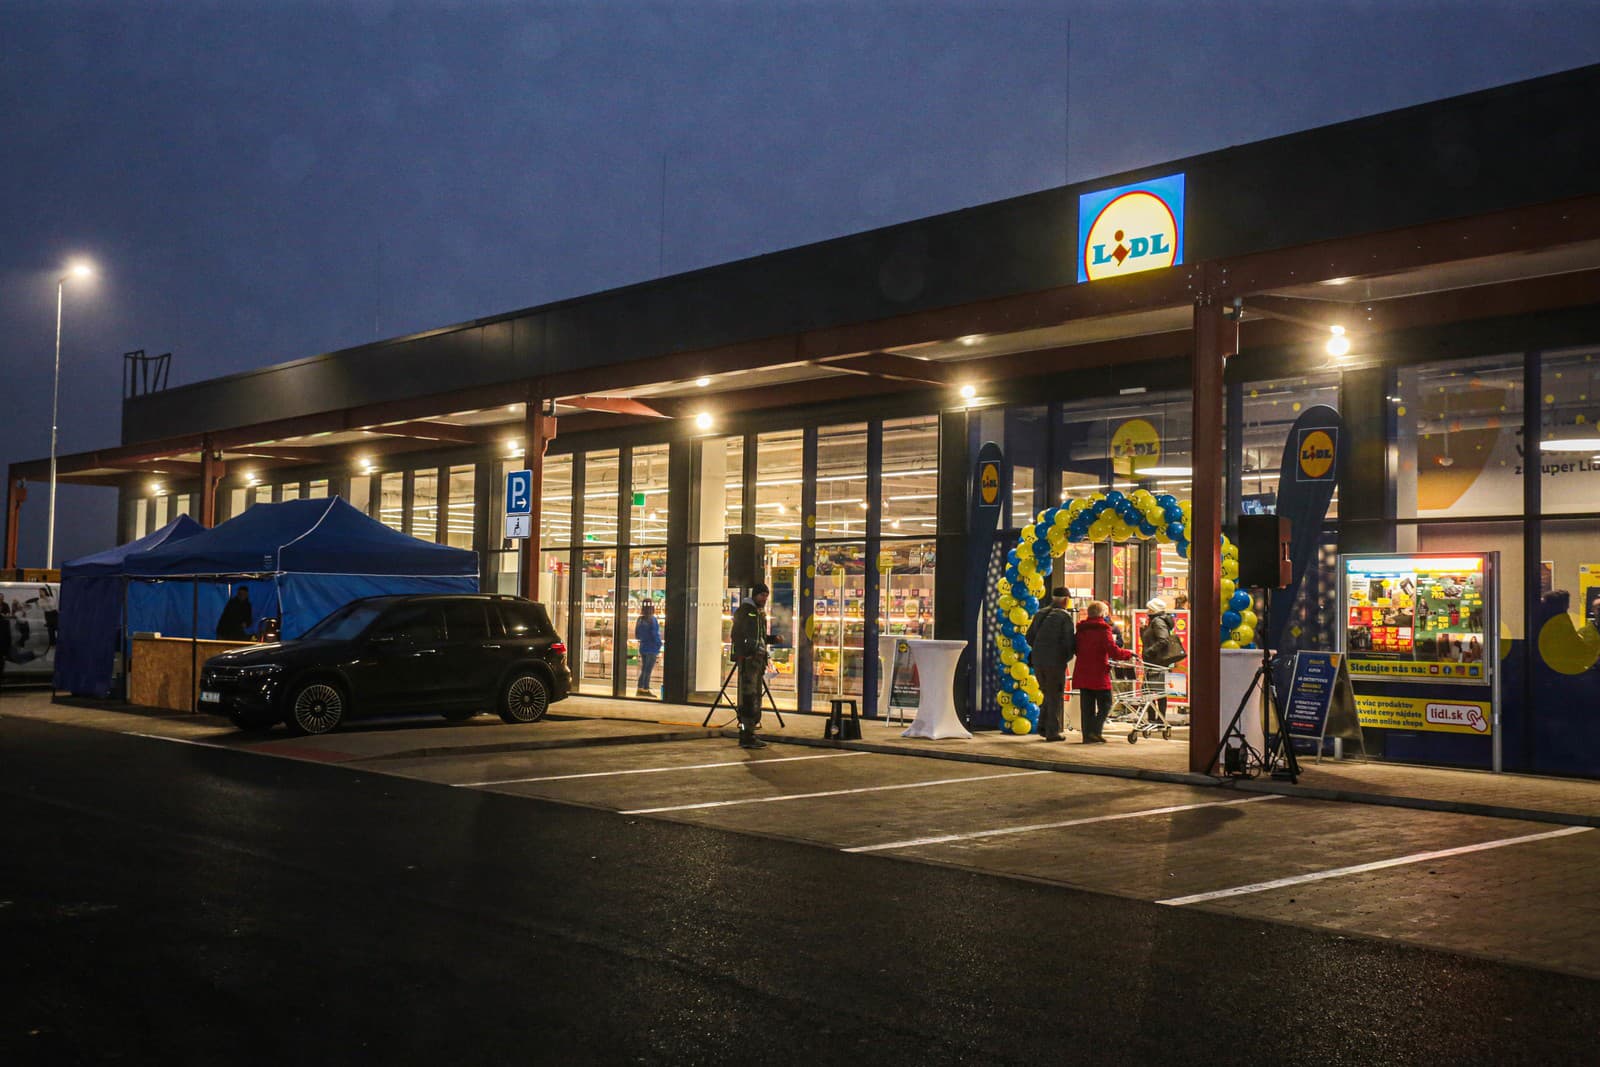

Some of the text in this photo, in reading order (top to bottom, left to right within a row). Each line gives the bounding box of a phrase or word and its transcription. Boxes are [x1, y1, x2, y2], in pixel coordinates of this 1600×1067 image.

[1541, 462, 1576, 476] uper
[512, 476, 526, 509] P
[1350, 663, 1426, 674] Sledujte nás na:
[1377, 700, 1413, 709] produktov
[1430, 708, 1463, 720] lidl.sk
